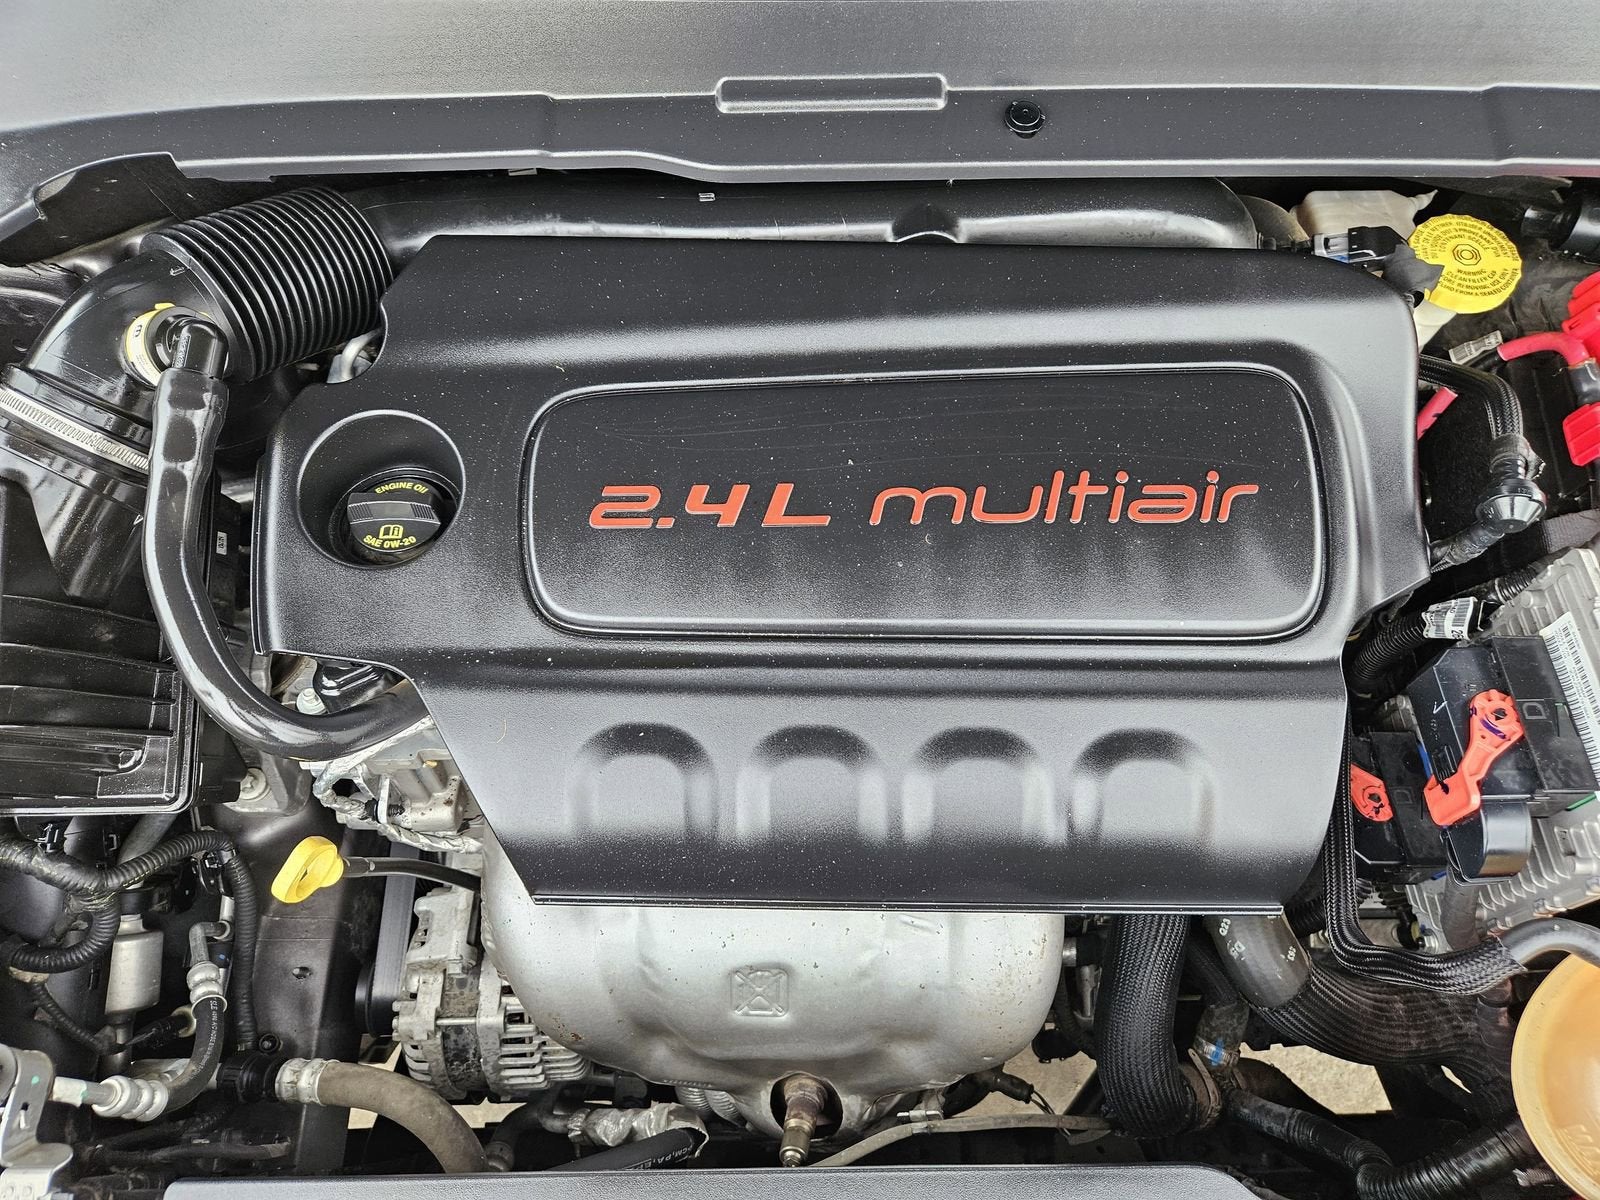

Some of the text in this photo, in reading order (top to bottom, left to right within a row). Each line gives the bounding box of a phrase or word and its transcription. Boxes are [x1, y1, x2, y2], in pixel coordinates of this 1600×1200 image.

[374, 481, 414, 494] ENGINE
[869, 470, 1260, 526] multiair
[589, 482, 831, 529] 2.4 L
[363, 534, 417, 549] SAE 0W-20
